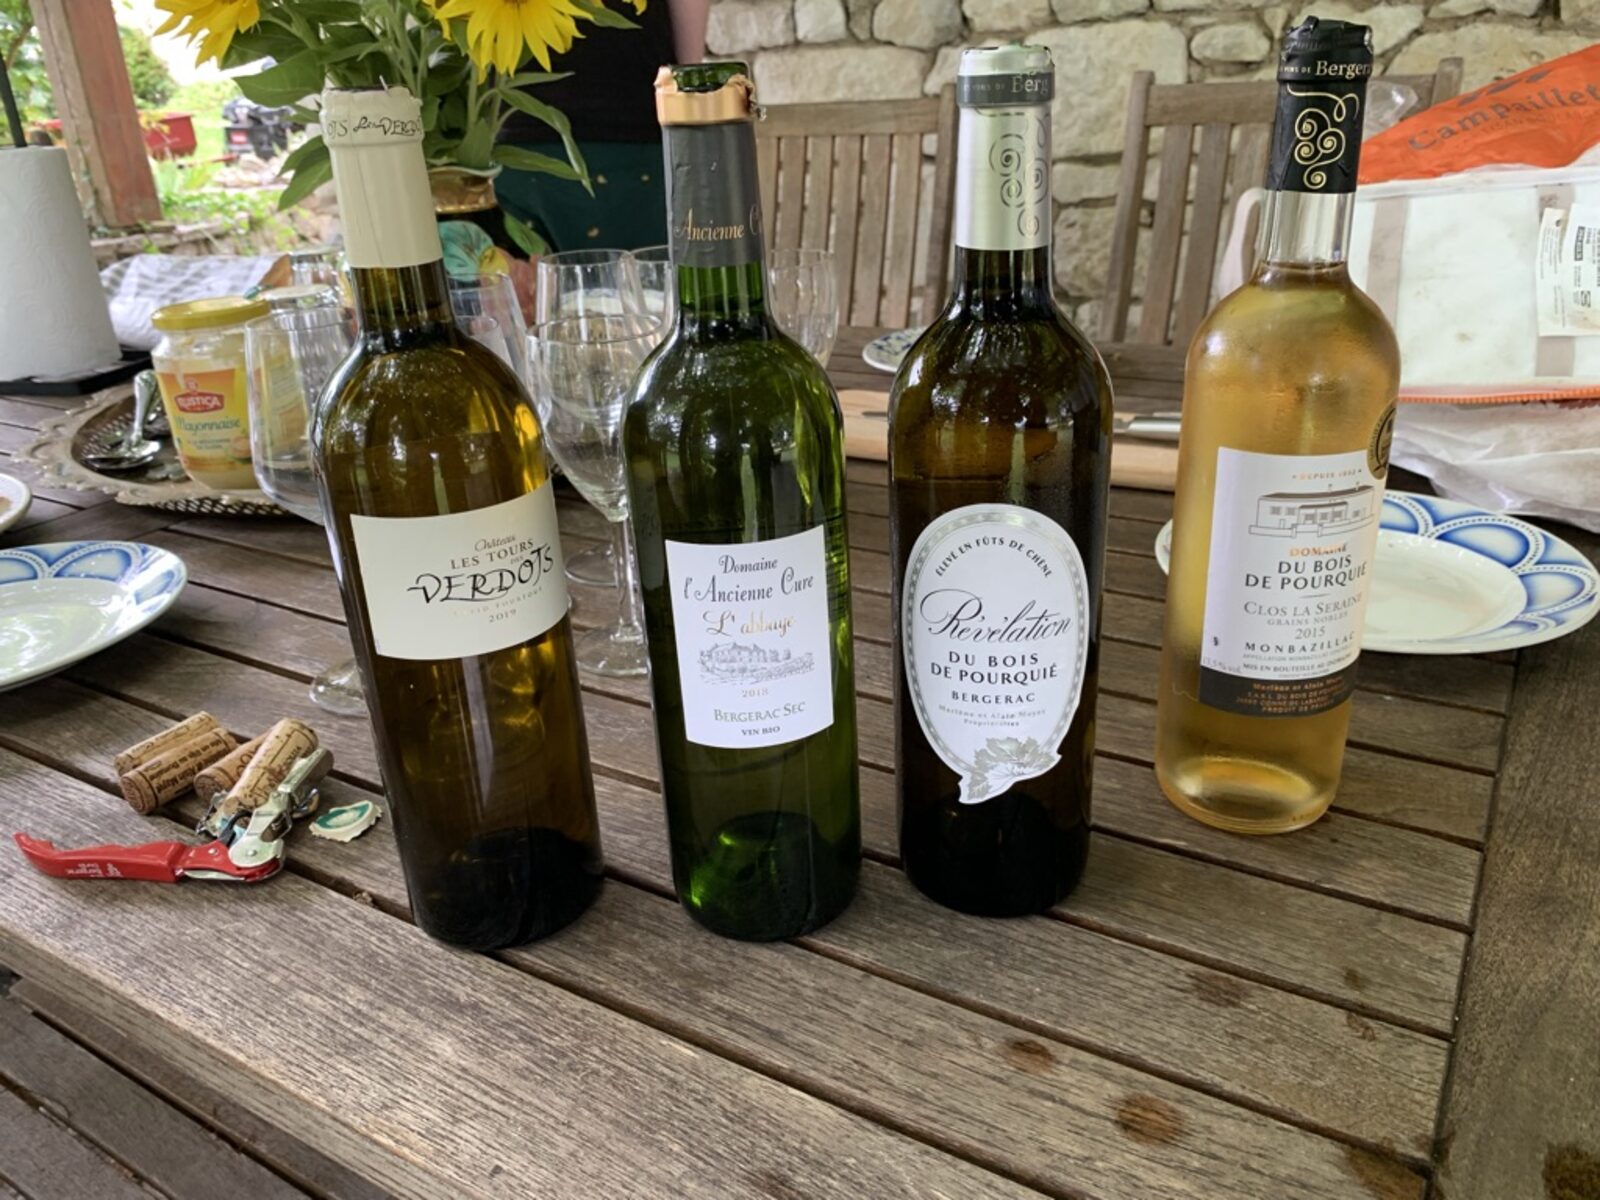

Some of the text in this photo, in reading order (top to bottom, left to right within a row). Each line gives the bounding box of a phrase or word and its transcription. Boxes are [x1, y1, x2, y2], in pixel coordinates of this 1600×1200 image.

[674, 208, 746, 242] Ancienne
[174, 416, 241, 432] Mayonnaise
[451, 539, 534, 570] LES TOURS
[958, 542, 973, 554] EN
[976, 535, 1005, 546] FÛTS
[1008, 539, 1025, 552] DE
[1026, 549, 1052, 578] CHÊNE
[1289, 543, 1348, 557] DOMAINE
[718, 554, 778, 574] Domaine
[1278, 554, 1352, 574] DU BOIS
[407, 543, 554, 604] VERDOTS
[1245, 574, 1272, 589] DE
[684, 566, 814, 602] l'Ancienne Cure
[489, 609, 517, 623] 2019
[920, 588, 1072, 642] Révélation
[1243, 601, 1288, 616] CLOS
[1293, 606, 1311, 616] LA
[1267, 611, 1348, 627] GRAINS NOBLES
[1294, 626, 1326, 640] 2015
[1244, 631, 1355, 654] MONBAZILLAC
[949, 651, 1039, 668] DU BOIS
[1243, 663, 1258, 671] MIS
[930, 662, 1058, 685] DE POURQUIÉ
[742, 688, 769, 698] 2018
[951, 690, 1036, 704] BERGERAC
[713, 702, 806, 723] BERGERAC SEC
[762, 726, 781, 735] BIO
